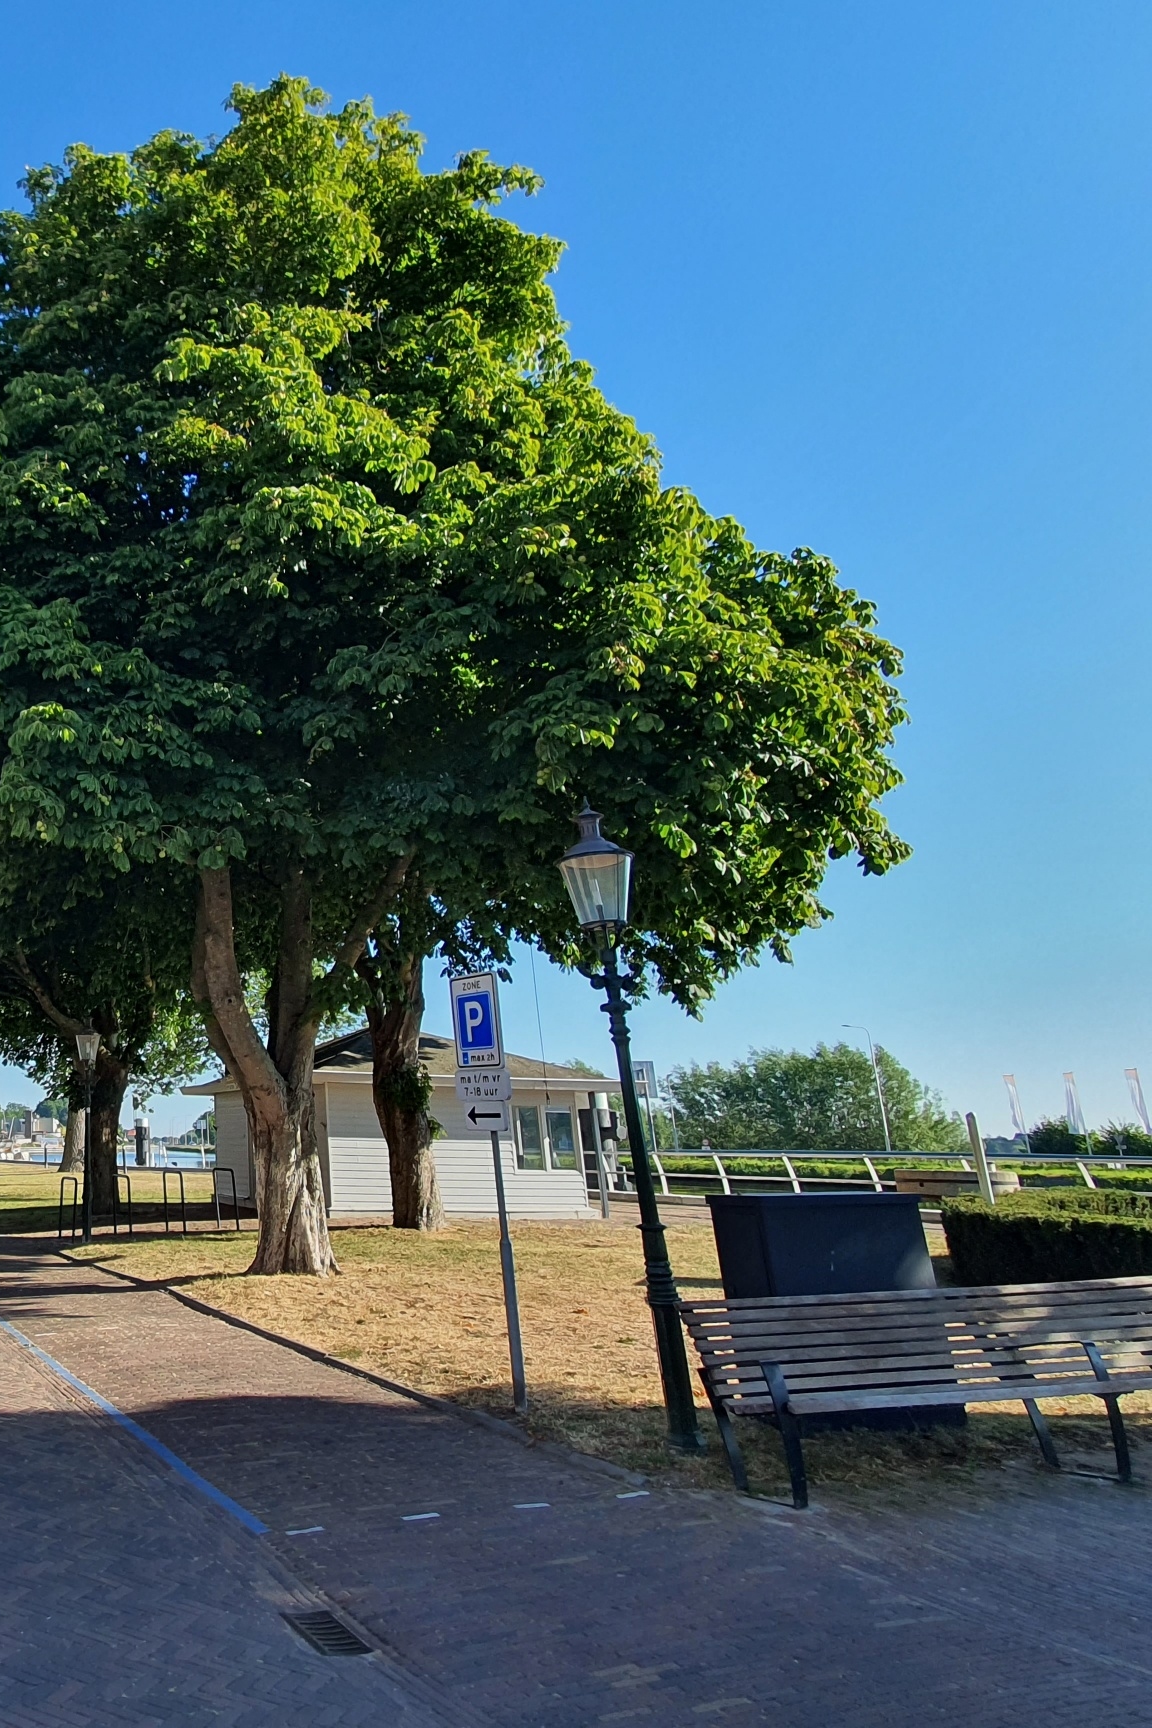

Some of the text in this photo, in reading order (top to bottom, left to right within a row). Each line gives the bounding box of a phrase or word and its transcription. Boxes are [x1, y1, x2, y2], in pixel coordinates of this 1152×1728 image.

[462, 981, 481, 991] ZONE
[464, 1001, 483, 1043] P
[470, 1052, 495, 1062] max 2h
[460, 1072, 501, 1084] ma t/m vr
[464, 1087, 498, 1096] 7-18 uur
